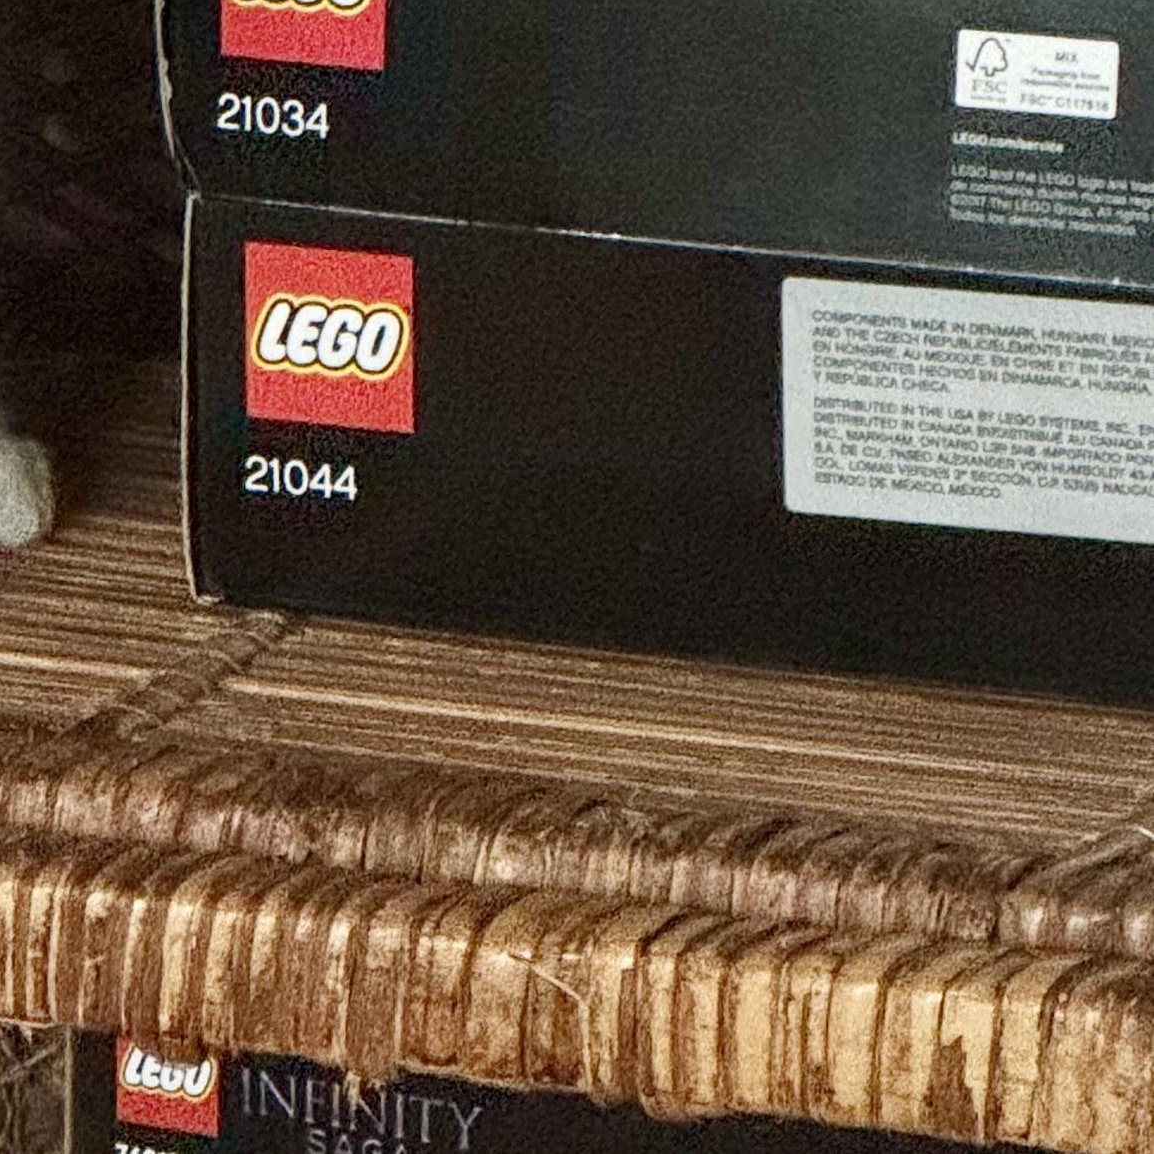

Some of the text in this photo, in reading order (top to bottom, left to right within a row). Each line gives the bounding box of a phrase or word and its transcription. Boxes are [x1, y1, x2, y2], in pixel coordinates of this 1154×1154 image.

[971, 79, 1007, 93] FSC
[216, 92, 329, 139] 21034
[812, 311, 905, 329] COMPONENTS
[910, 318, 946, 332] MADE
[951, 321, 964, 333] IN
[812, 326, 840, 339] AND
[844, 328, 868, 341] THE
[873, 330, 918, 345] CZECH
[252, 293, 410, 381] LEGO
[813, 341, 829, 353] EN
[903, 348, 920, 360] AU
[991, 355, 1008, 367] EN
[1012, 357, 1054, 371] CHINE
[1059, 360, 1074, 372] ET
[1080, 362, 1098, 374] EN
[813, 356, 914, 375] COMPONENTES
[919, 365, 974, 380] HECHOS
[978, 369, 997, 381] EN
[813, 372, 822, 383] Y
[814, 397, 897, 414] DISTRIBUTED
[901, 404, 913, 415] IN
[918, 405, 942, 418] THE
[947, 407, 973, 420] USA
[978, 410, 993, 422] BY
[997, 411, 1035, 425] LEGO
[814, 412, 897, 429] DISTRIBUTED
[901, 419, 913, 430] IN
[917, 420, 971, 435] CANADA
[1067, 432, 1085, 444] AU
[1089, 433, 1143, 448] CANADA
[840, 444, 857, 456] DE
[890, 448, 932, 462] PASEO
[937, 452, 1015, 469] ALEXANDER
[1020, 458, 1047, 471] VON
[1051, 461, 1124, 477] HUMBOLDT
[920, 436, 978, 451] ONTARIO
[1042, 446, 1121, 462] IMPORTADO
[244, 456, 357, 500] 21044
[814, 472, 864, 487] ESTADO
[869, 476, 886, 488] DE
[848, 460, 894, 474] LOMAS
[898, 464, 949, 479] VERDES
[242, 1067, 482, 1150] INFINITY
